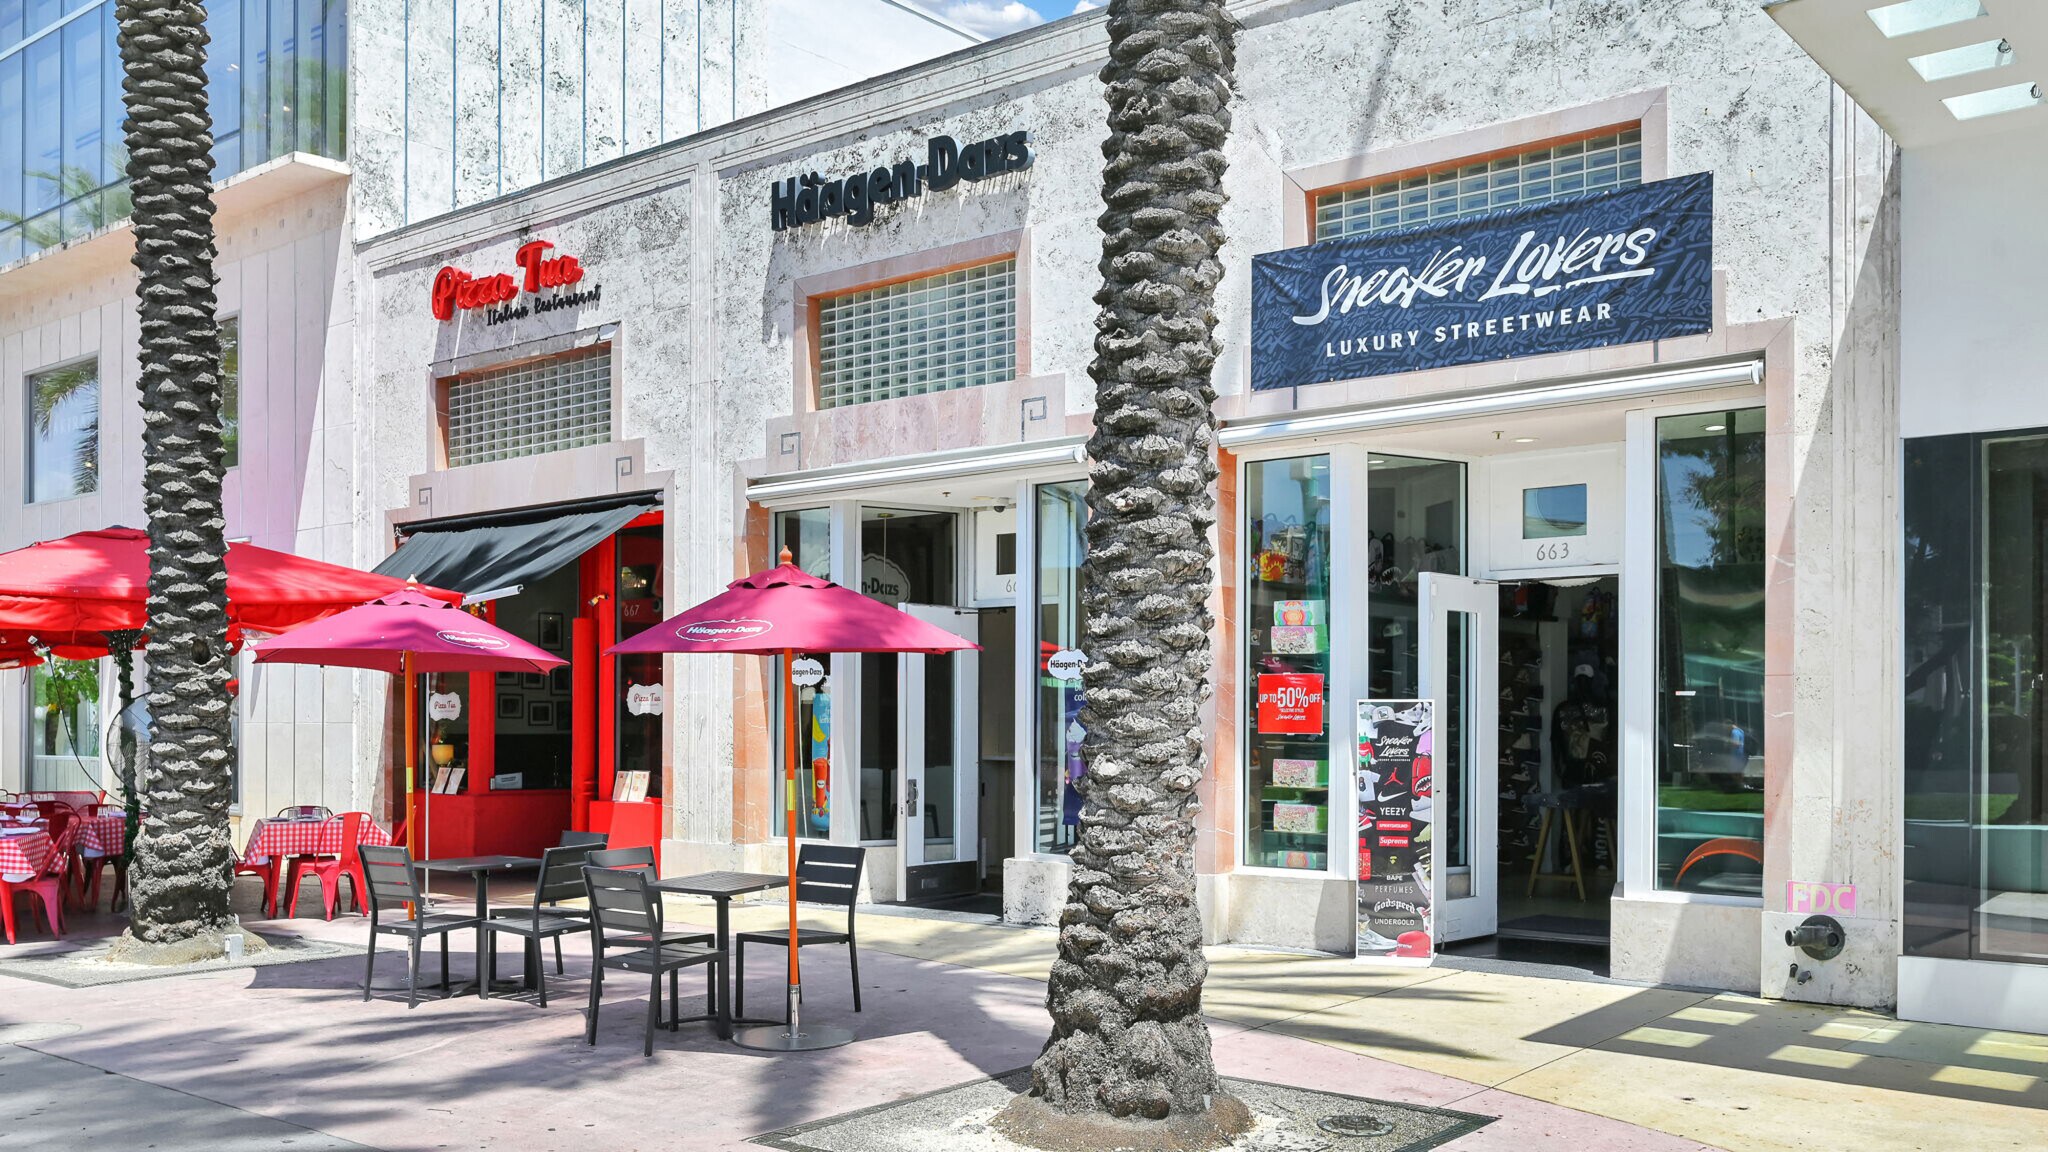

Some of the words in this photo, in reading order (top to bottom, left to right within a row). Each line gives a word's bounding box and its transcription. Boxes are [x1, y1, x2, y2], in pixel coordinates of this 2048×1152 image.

[771, 130, 1036, 232] Häagen-Dazs
[432, 265, 519, 321] Pizza
[516, 240, 585, 293] Tua
[1292, 245, 1488, 326] Sneaker
[1477, 226, 1657, 303] Lovers
[486, 303, 530, 326] Italian
[533, 283, 602, 313] Restaurant
[1326, 329, 1420, 358] LUXURY
[1434, 302, 1612, 343] STREETWEAR
[1536, 542, 1569, 561] 663
[861, 577, 899, 596] n-Dazs
[624, 604, 640, 617] 667
[792, 667, 823, 678] äagen-Dazs
[1050, 660, 1083, 672] Häagen-D
[632, 692, 649, 704] Pizza
[649, 692, 661, 702] Tua
[1259, 693, 1269, 703] UP
[1269, 693, 1277, 703] TO
[1277, 687, 1309, 708] 50%
[1309, 693, 1321, 703] OFF
[1375, 735, 1413, 746] Sneaker
[1379, 745, 1410, 757] Lovers
[1380, 807, 1406, 816] YEEZY
[1379, 836, 1409, 846] Supreme
[1374, 885, 1414, 894] PERFUMES
[1373, 898, 1416, 915] Godspeed
[1792, 883, 1853, 914] FDC
